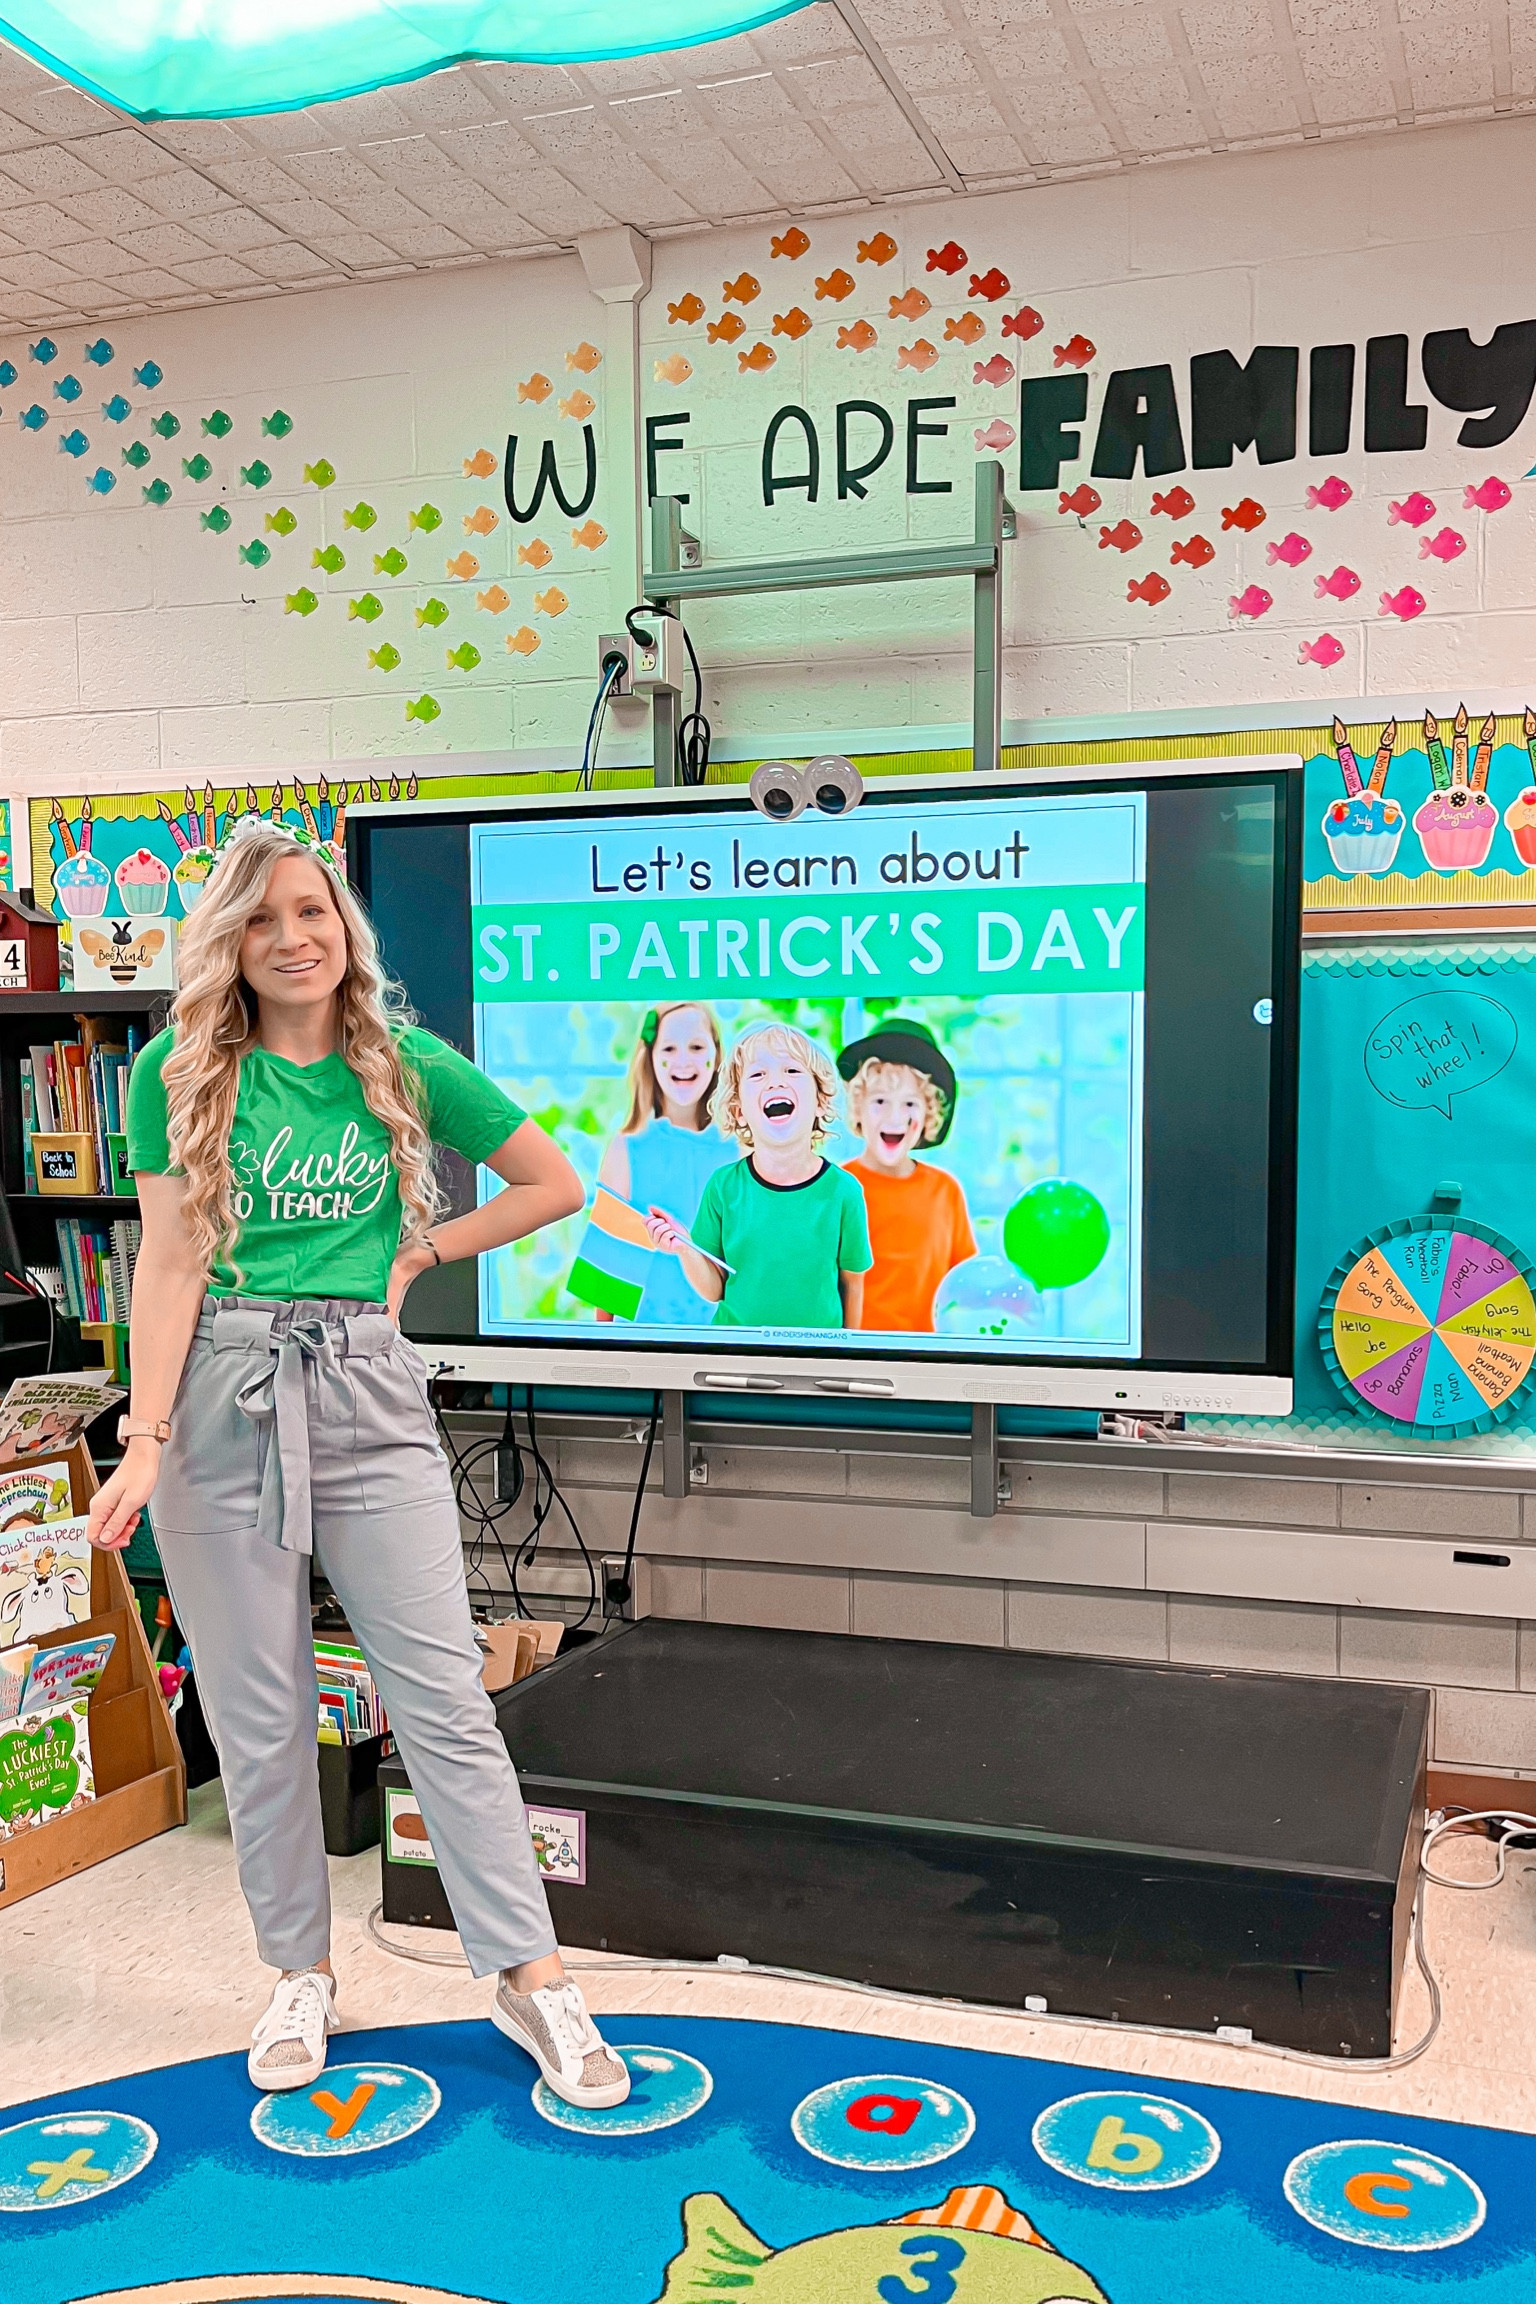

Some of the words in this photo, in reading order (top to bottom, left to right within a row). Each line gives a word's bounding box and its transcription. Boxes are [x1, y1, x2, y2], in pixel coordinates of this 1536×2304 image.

[505, 413, 691, 523] WE
[763, 397, 956, 507] ARE
[1020, 320, 1536, 490] FAMILY
[1340, 751, 1359, 791] Charlotte
[1371, 755, 1388, 785] Nolan
[1428, 743, 1446, 780] Logan
[1455, 741, 1466, 785] Coleman
[1473, 752, 1489, 788] Tristan
[1352, 813, 1374, 831] July
[1434, 808, 1475, 827] August
[172, 826, 186, 847] Izzy
[591, 843, 712, 894] Let's
[732, 839, 858, 889] learn
[880, 830, 1030, 885] about
[98, 948, 115, 962] Bee
[111, 945, 149, 966] Kind
[478, 924, 560, 984] ST.
[589, 910, 945, 981] PATRICK'S
[977, 905, 1139, 974] DAY
[1372, 1021, 1423, 1059] Spin
[1414, 1020, 1458, 1059] that
[1416, 1022, 1485, 1089] wheel!
[42, 1152, 63, 1163] Back
[64, 1152, 74, 1163] to
[49, 1165, 76, 1178] School
[262, 1122, 392, 1215] lucky
[266, 1191, 350, 1220] TEACH
[1404, 1245, 1415, 1269] Run
[1416, 1237, 1430, 1284] Meatball
[1431, 1236, 1445, 1276] Fabio's
[1482, 1257, 1505, 1275] Oh
[1364, 1257, 1380, 1278] The
[1382, 1278, 1416, 1315] Penguin
[1450, 1257, 1479, 1299] Fabio!
[1356, 1281, 1383, 1309] Song
[1485, 1303, 1519, 1318] Song
[1340, 1320, 1371, 1333] Hello
[1461, 1324, 1507, 1338] Jellyfish
[1512, 1326, 1532, 1337] The
[1364, 1340, 1387, 1354] Joe
[1477, 1342, 1522, 1373] Meatball
[1363, 1378, 1383, 1394] Go
[1387, 1346, 1423, 1397] Bananas
[1467, 1363, 1505, 1399] Banana
[1476, 1356, 1513, 1387] Banana
[47, 1390, 76, 1398] LADY
[76, 1391, 102, 1399] WHO
[1432, 1383, 1445, 1419] Pizza
[1447, 1372, 1464, 1402] Man
[5, 1398, 57, 1408] SWALLOWED
[12, 1475, 47, 1489] Littlest
[0, 1538, 28, 1556] Click,
[33, 1652, 84, 1682] SPRING
[42, 1674, 57, 1688] IS
[65, 1653, 104, 1679] HERE!
[2, 1740, 68, 1776] LUCKIEST
[12, 1738, 28, 1752] The
[6, 1777, 19, 1790] St.
[19, 1760, 53, 1781] Patrick's
[54, 1757, 70, 1774] Day
[29, 1774, 51, 1792] Ever!
[403, 1849, 427, 1858] potato
[846, 2093, 922, 2136] a
[1086, 2115, 1163, 2174] b
[876, 2234, 967, 2304] 3
